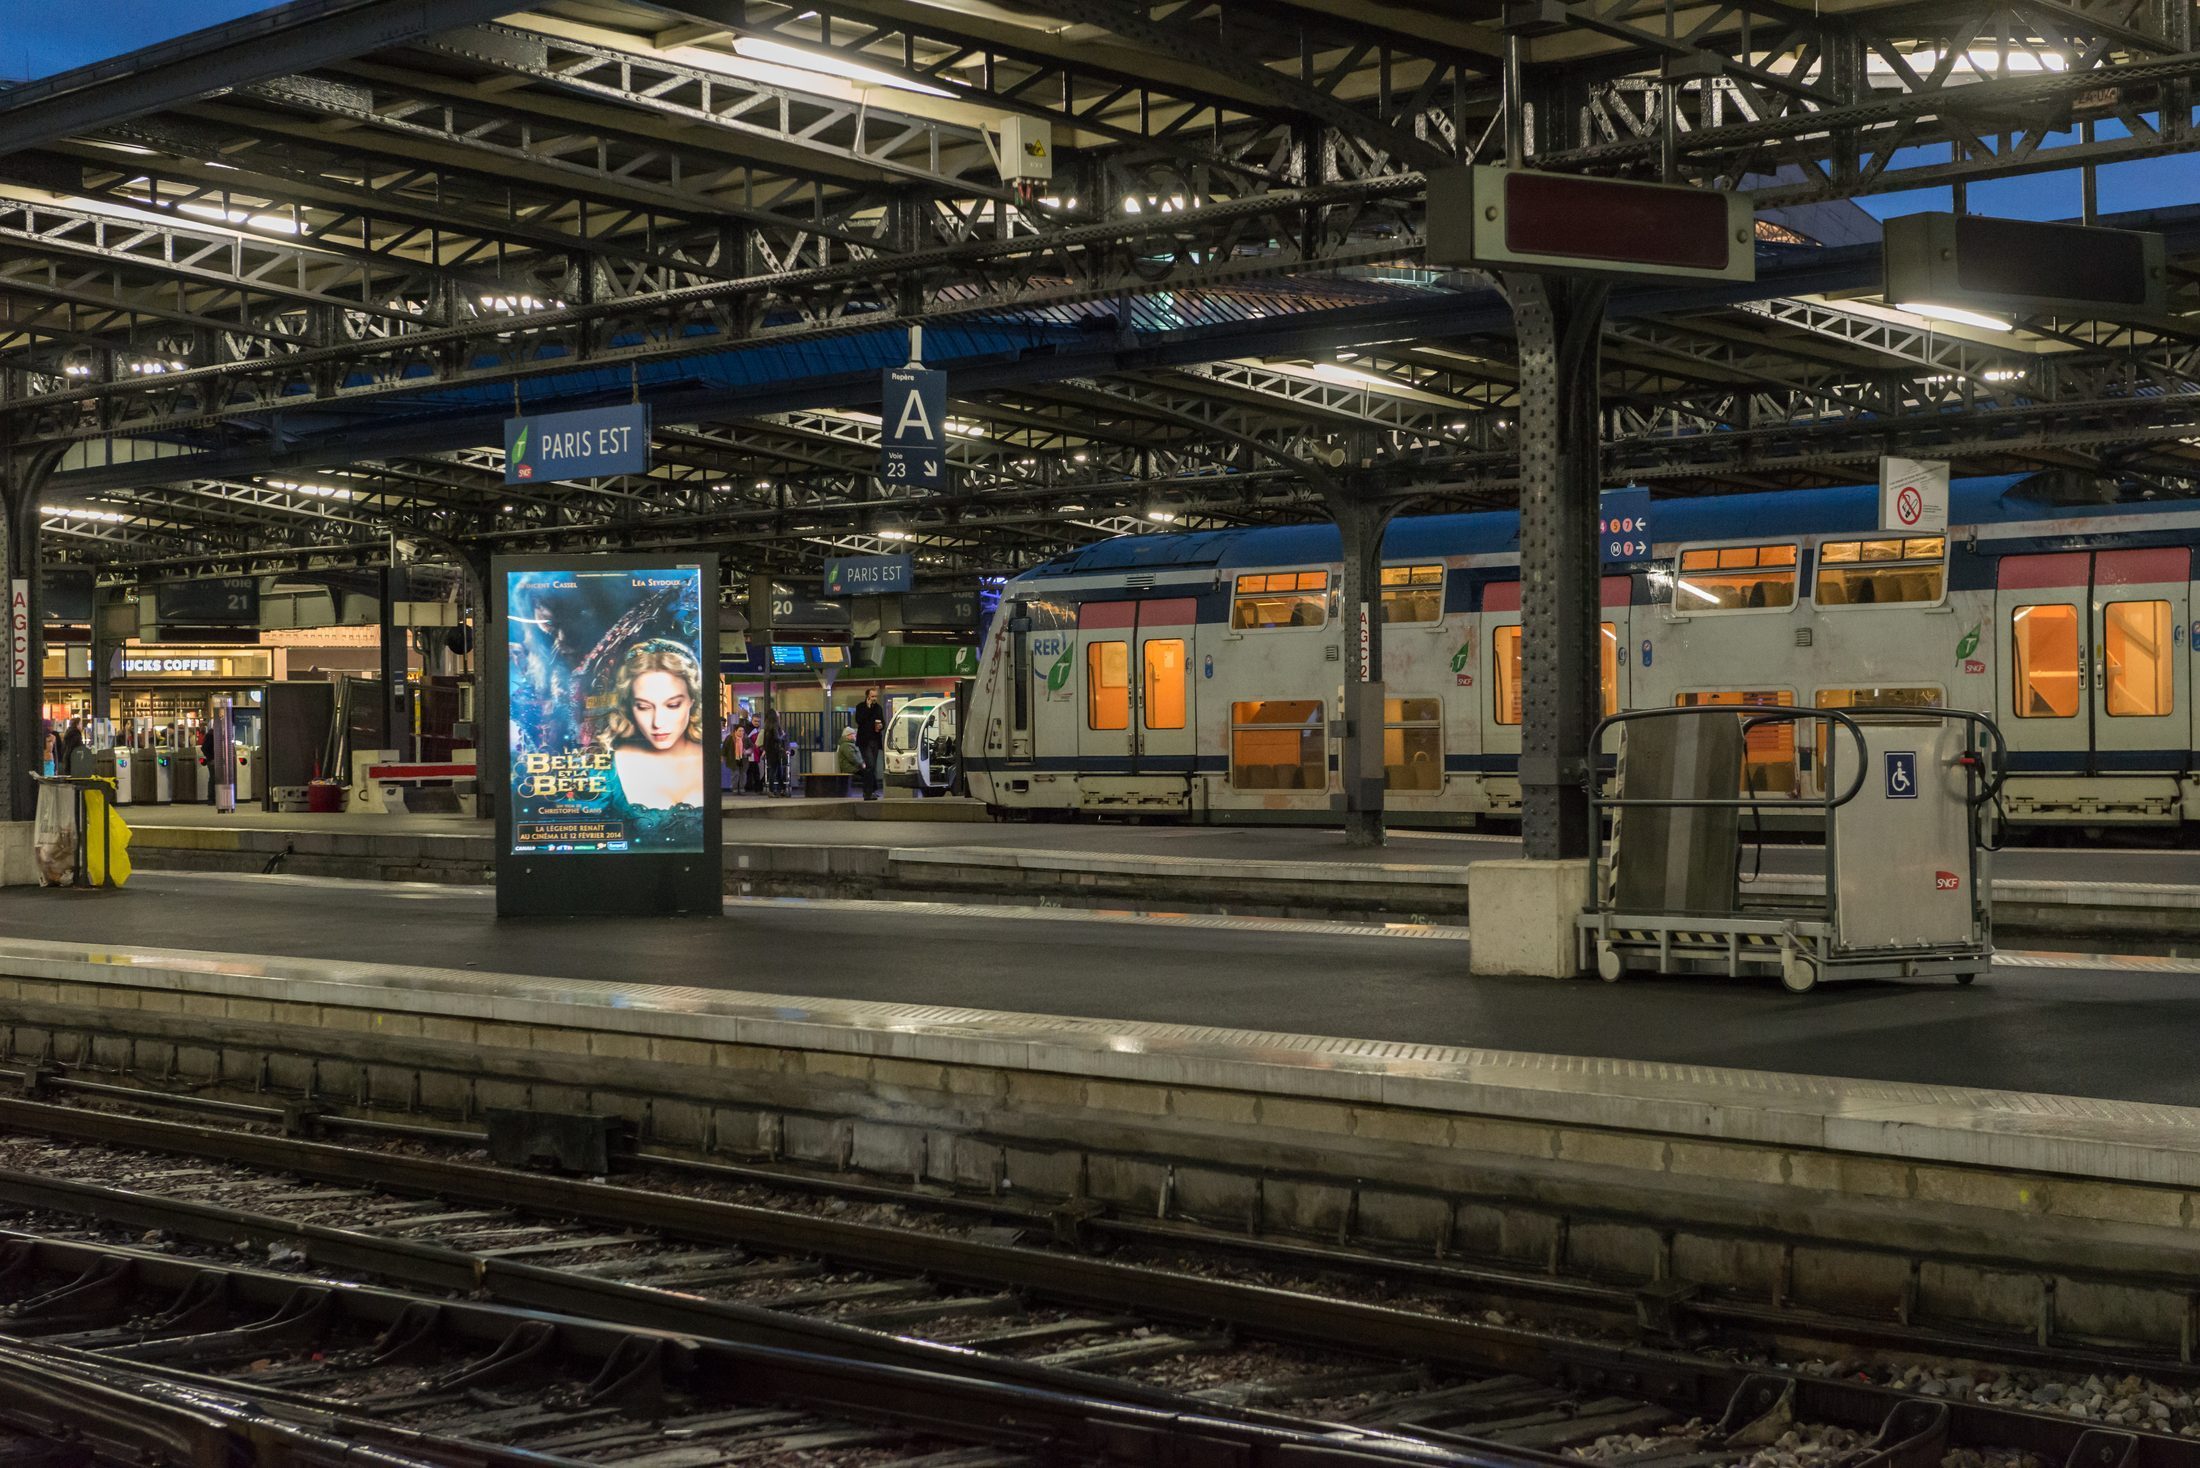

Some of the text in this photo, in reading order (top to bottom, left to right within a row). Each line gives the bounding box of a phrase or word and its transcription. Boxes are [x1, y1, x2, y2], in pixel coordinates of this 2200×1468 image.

[891, 372, 915, 381] Repère
[894, 389, 934, 441] A
[542, 426, 631, 461] PARIS EST
[888, 452, 903, 460] Voie
[887, 462, 907, 478] 23
[847, 565, 902, 583] PARIS EST
[227, 594, 248, 610] 21
[772, 600, 793, 615] 20
[955, 603, 972, 617] 19
[1034, 638, 1060, 656] RER
[163, 659, 215, 671] COFFEE
[564, 747, 579, 755] LA
[526, 753, 612, 774] BELLE
[606, 831, 622, 839] 2014
[1936, 878, 1958, 889] SNCF
